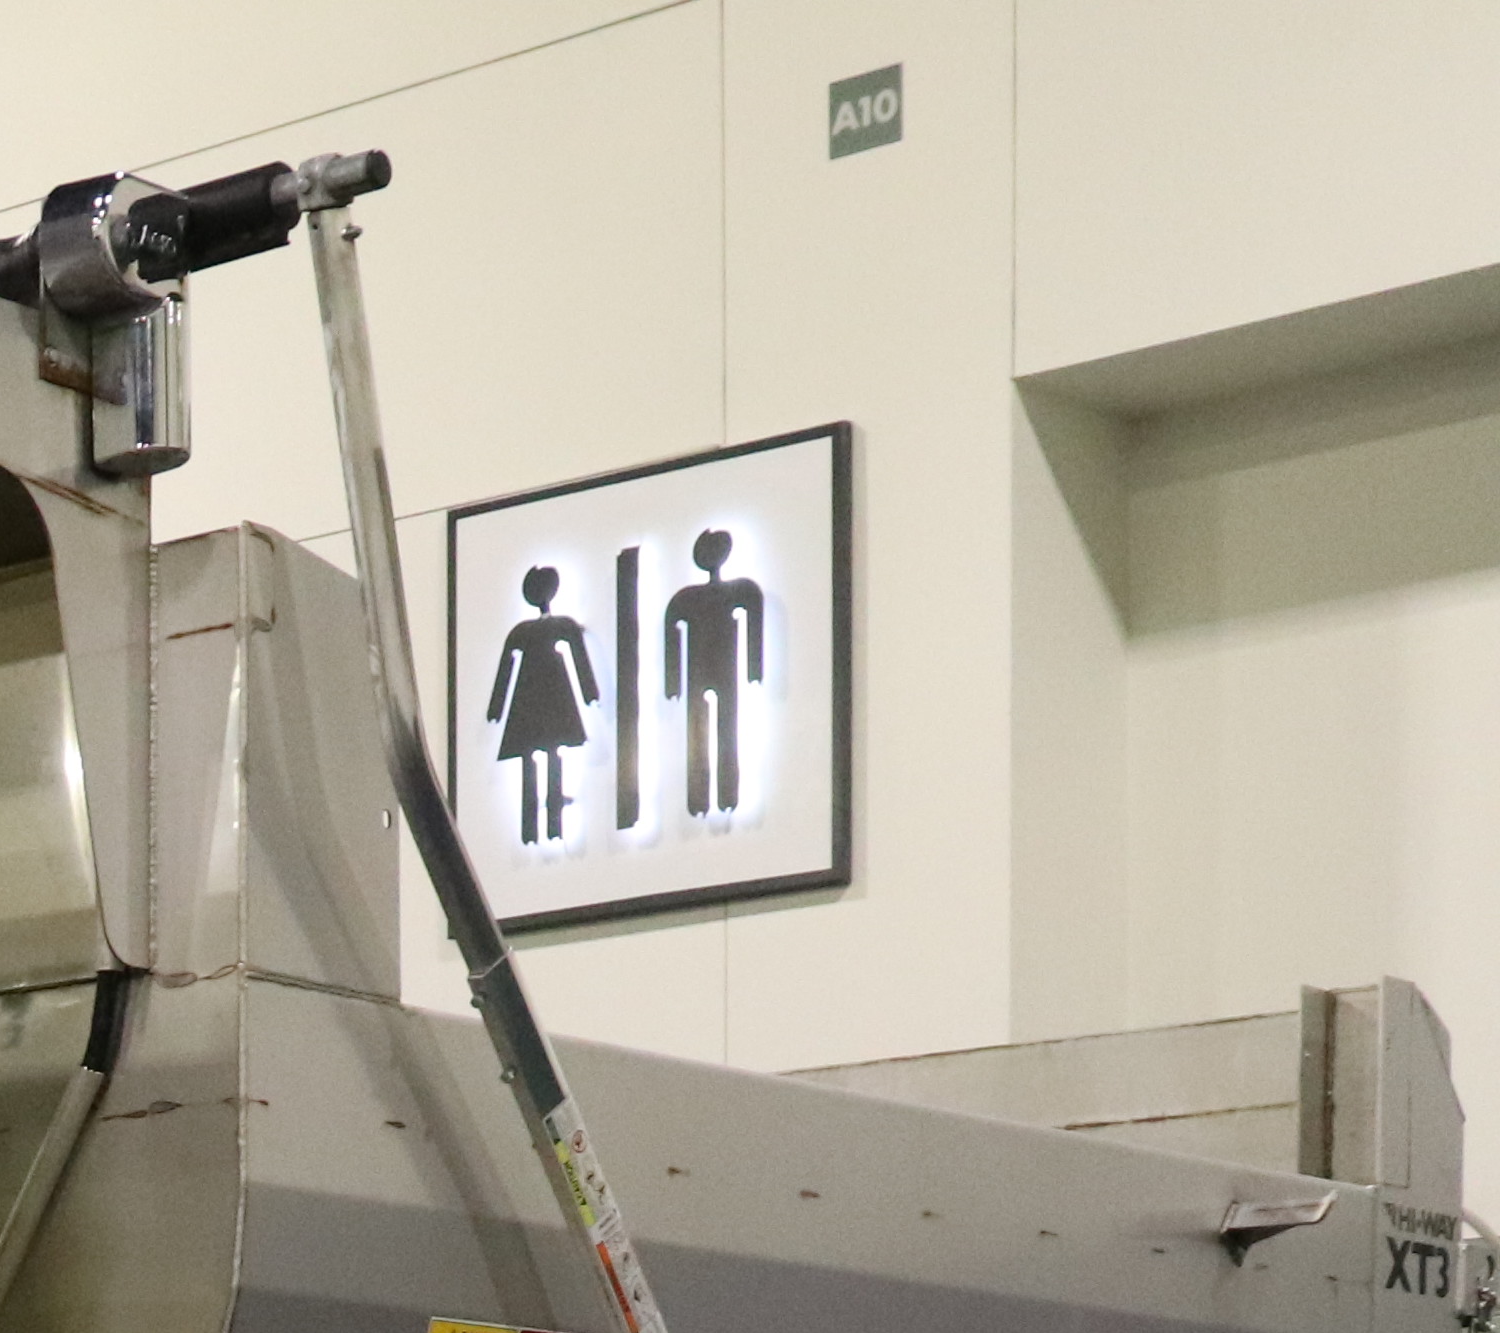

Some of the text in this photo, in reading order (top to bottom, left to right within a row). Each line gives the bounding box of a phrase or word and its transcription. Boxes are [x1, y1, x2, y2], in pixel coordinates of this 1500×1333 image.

[832, 88, 898, 136] A10
[1399, 1206, 1458, 1241] HI-WAY
[1386, 1236, 1450, 1298] XT3
